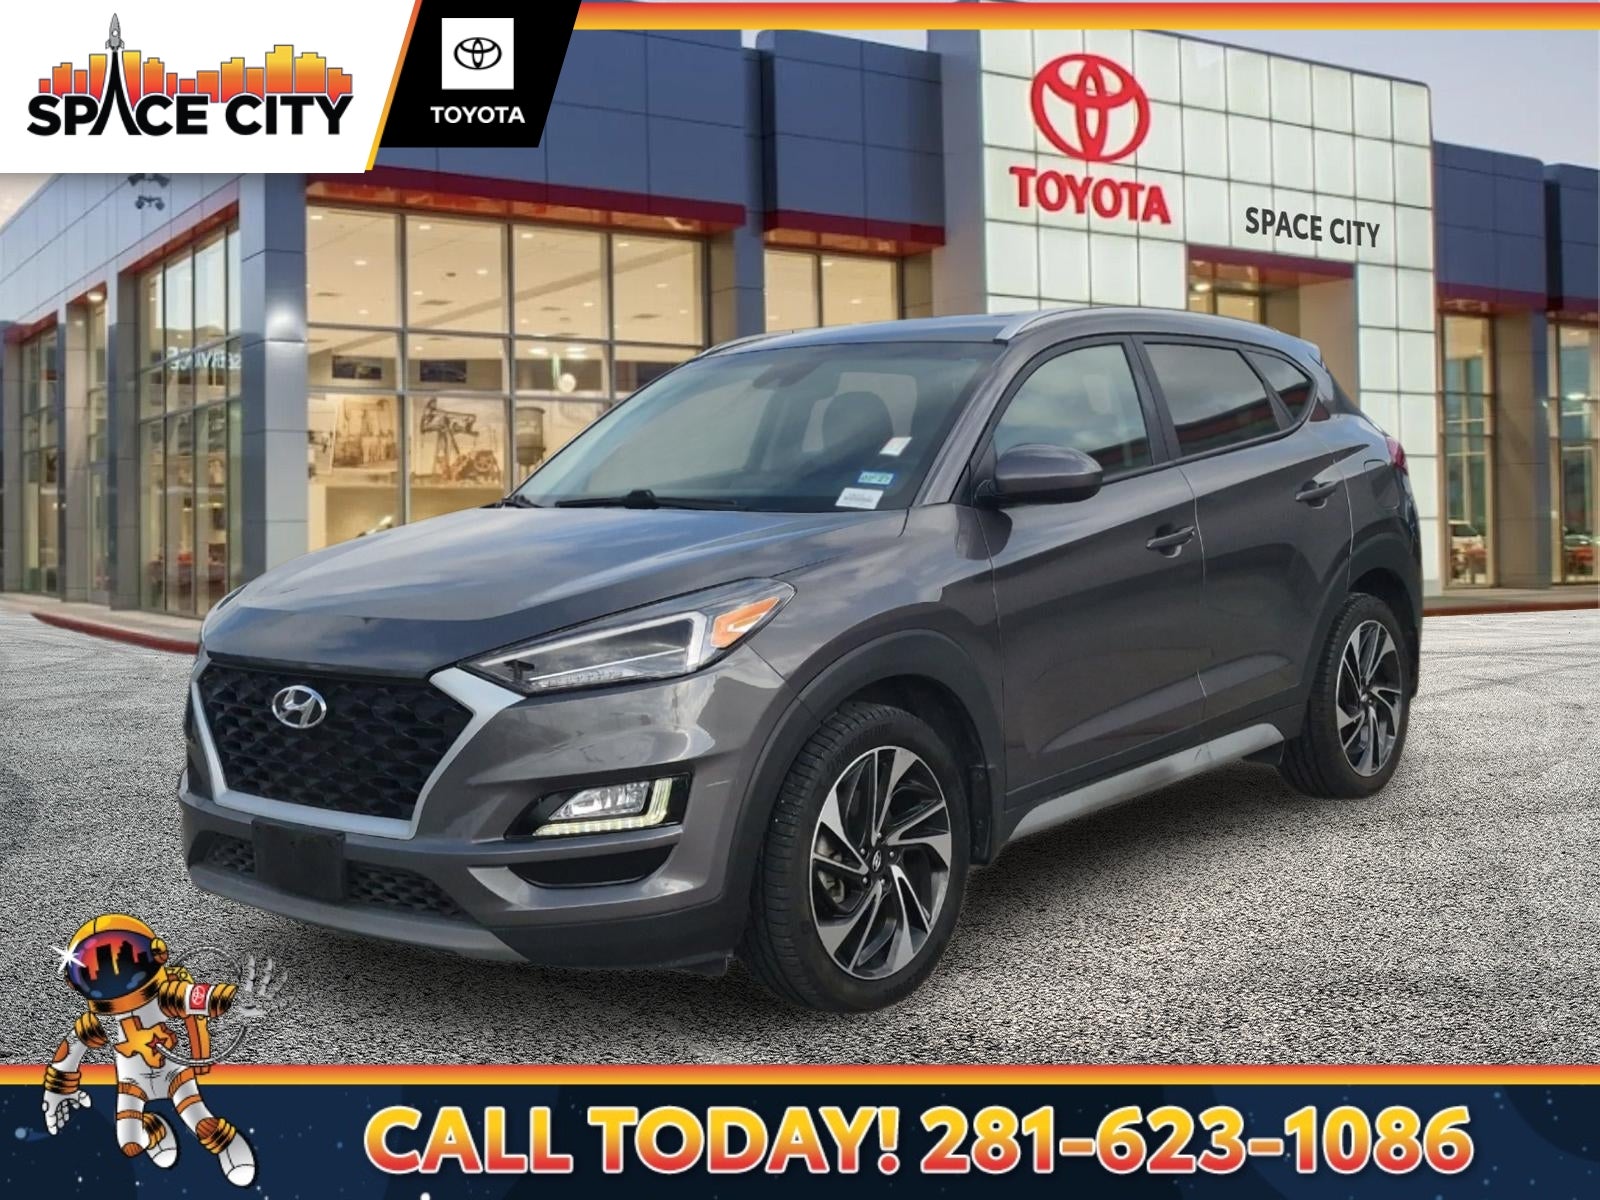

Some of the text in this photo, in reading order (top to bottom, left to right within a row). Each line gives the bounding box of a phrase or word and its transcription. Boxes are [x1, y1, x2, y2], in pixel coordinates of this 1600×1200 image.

[1009, 166, 1171, 224] TOYOTA
[1245, 207, 1381, 248] SPACE CITY
